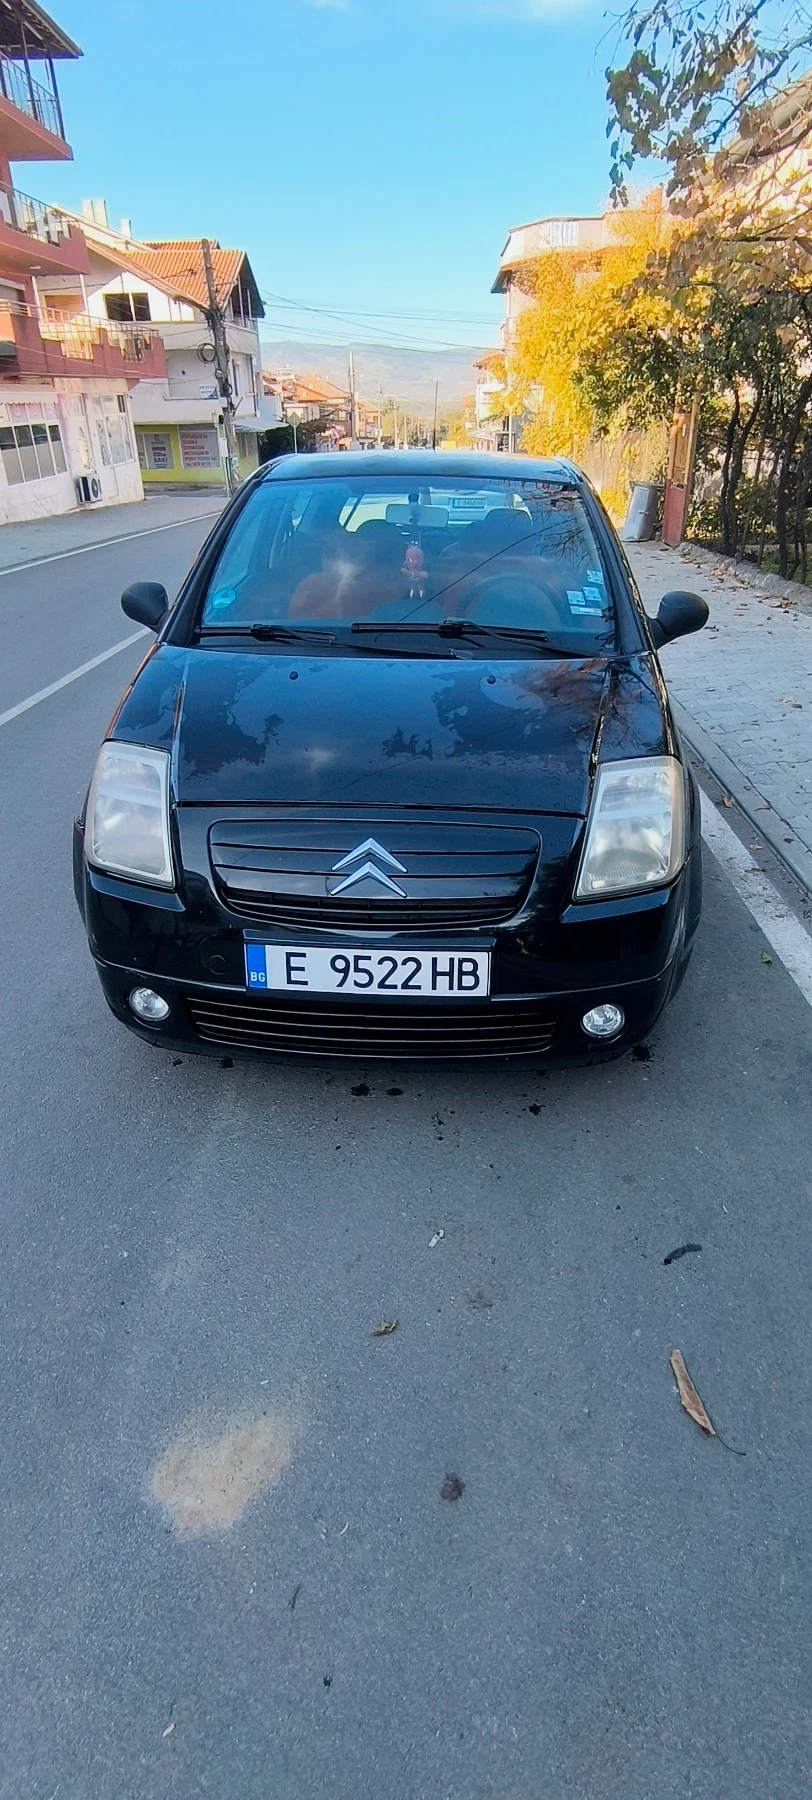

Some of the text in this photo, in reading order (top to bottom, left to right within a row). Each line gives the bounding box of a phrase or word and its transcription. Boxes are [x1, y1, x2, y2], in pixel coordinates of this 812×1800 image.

[250, 971, 266, 982] BG
[285, 952, 480, 991] E 9522 HB
